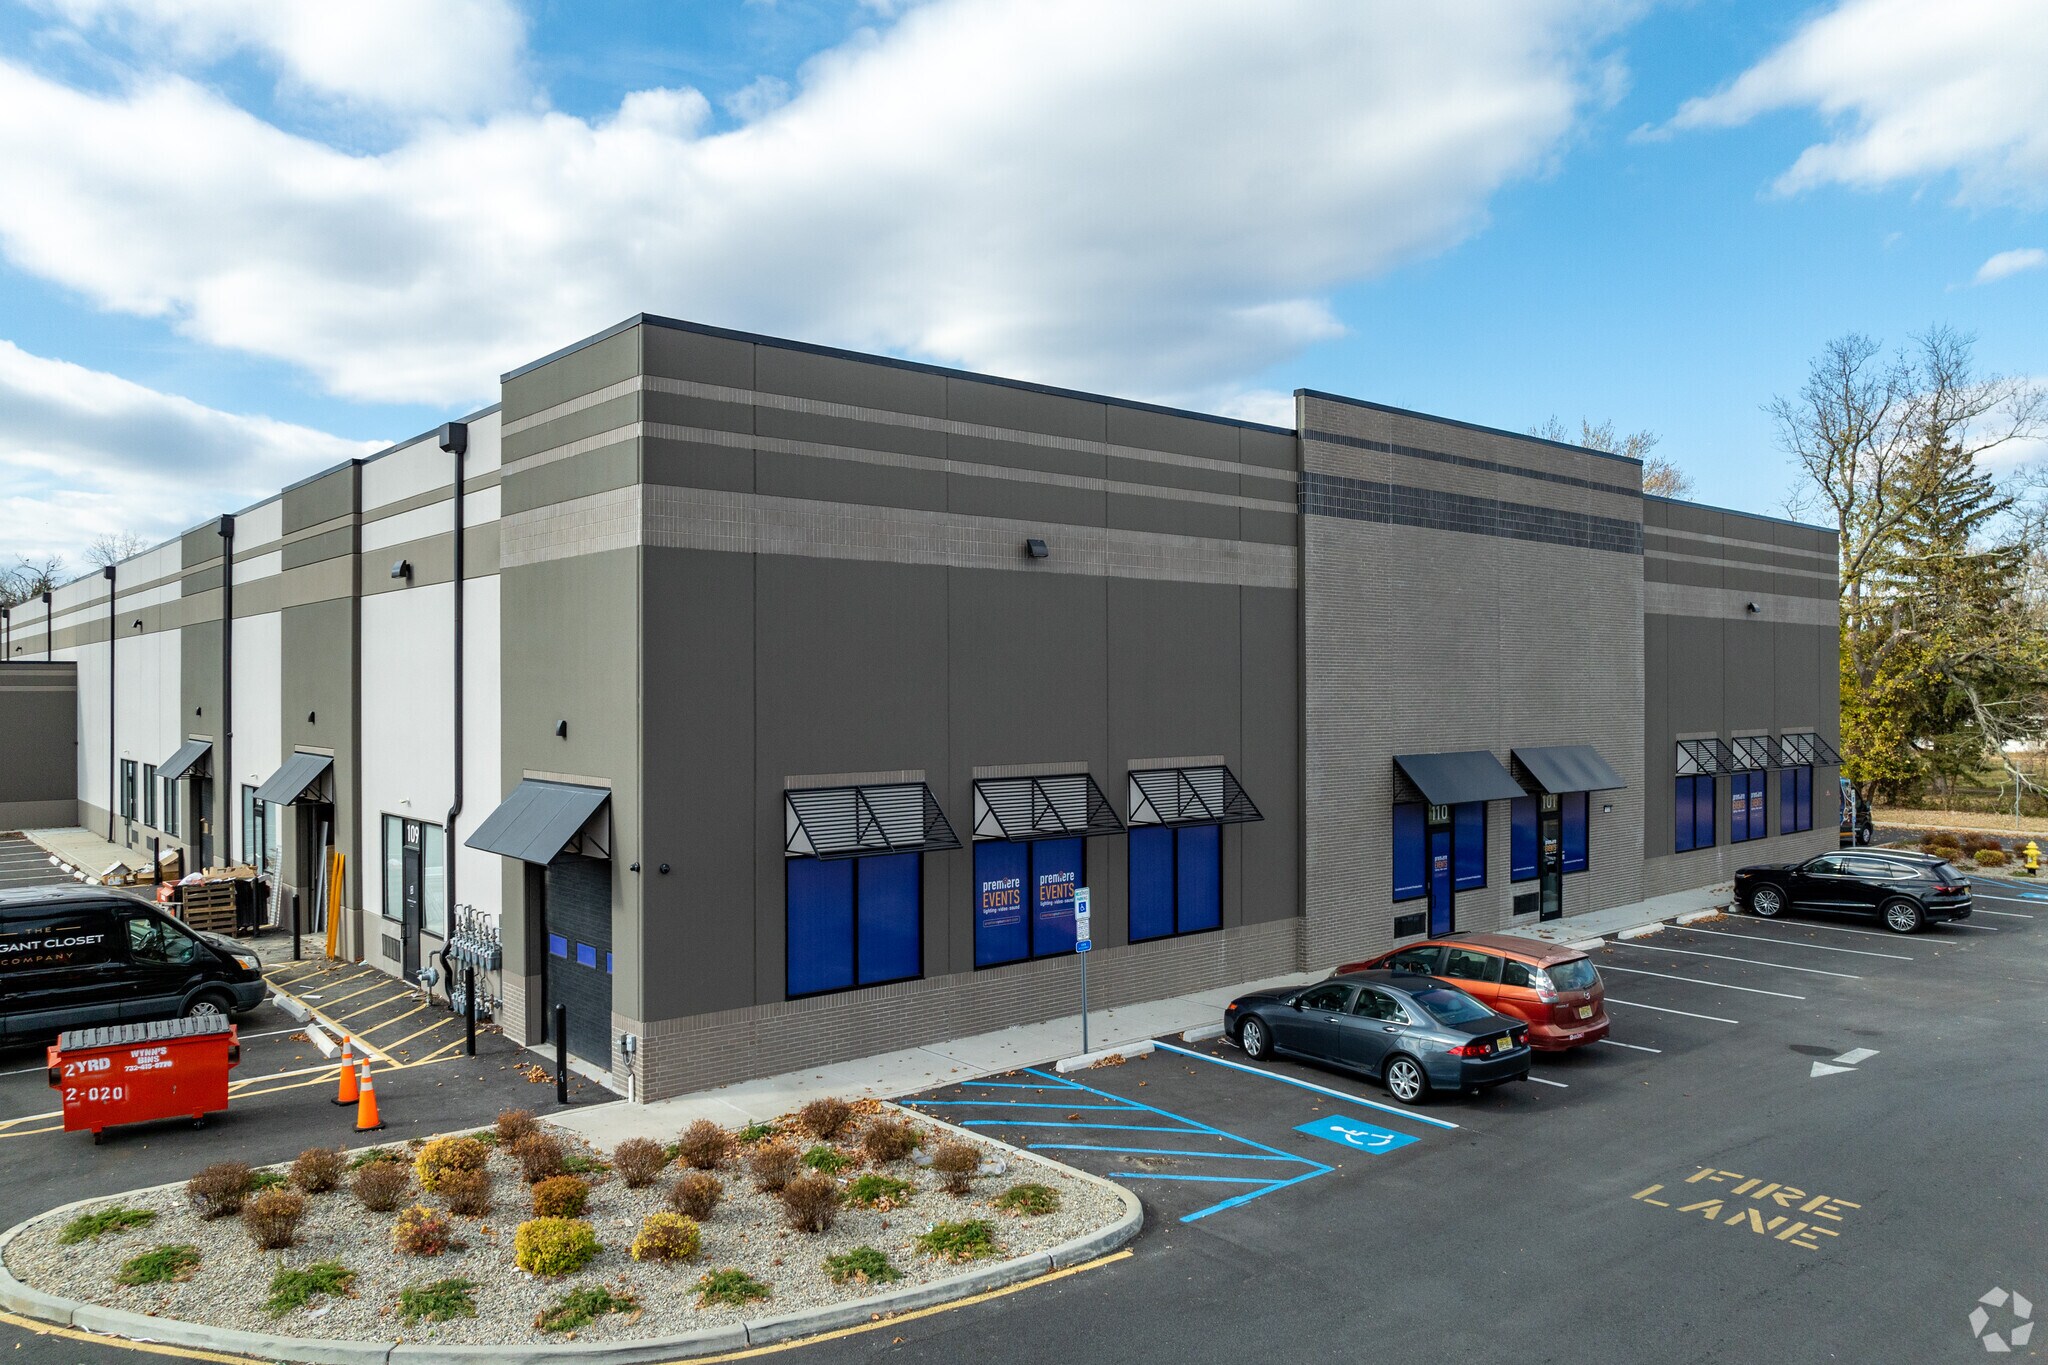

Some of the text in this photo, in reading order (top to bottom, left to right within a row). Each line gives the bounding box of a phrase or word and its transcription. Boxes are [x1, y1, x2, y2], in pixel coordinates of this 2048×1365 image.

[1542, 793, 1557, 809] 101
[1431, 804, 1448, 821] 110
[406, 824, 419, 844] 109
[983, 877, 1020, 892] premiere
[1040, 870, 1075, 886] premiere
[983, 889, 1020, 908] EVENTS
[1040, 882, 1075, 901] EVENTS
[25, 926, 52, 934] THE
[43, 934, 105, 948] CLOSET
[1, 952, 73, 966] COMPANY
[130, 1046, 167, 1058] WYNN'S
[137, 1055, 160, 1065] BINS
[65, 1086, 123, 1101] 2-020
[1684, 1167, 1862, 1221] FIRE
[1630, 1183, 1840, 1250] LANE
